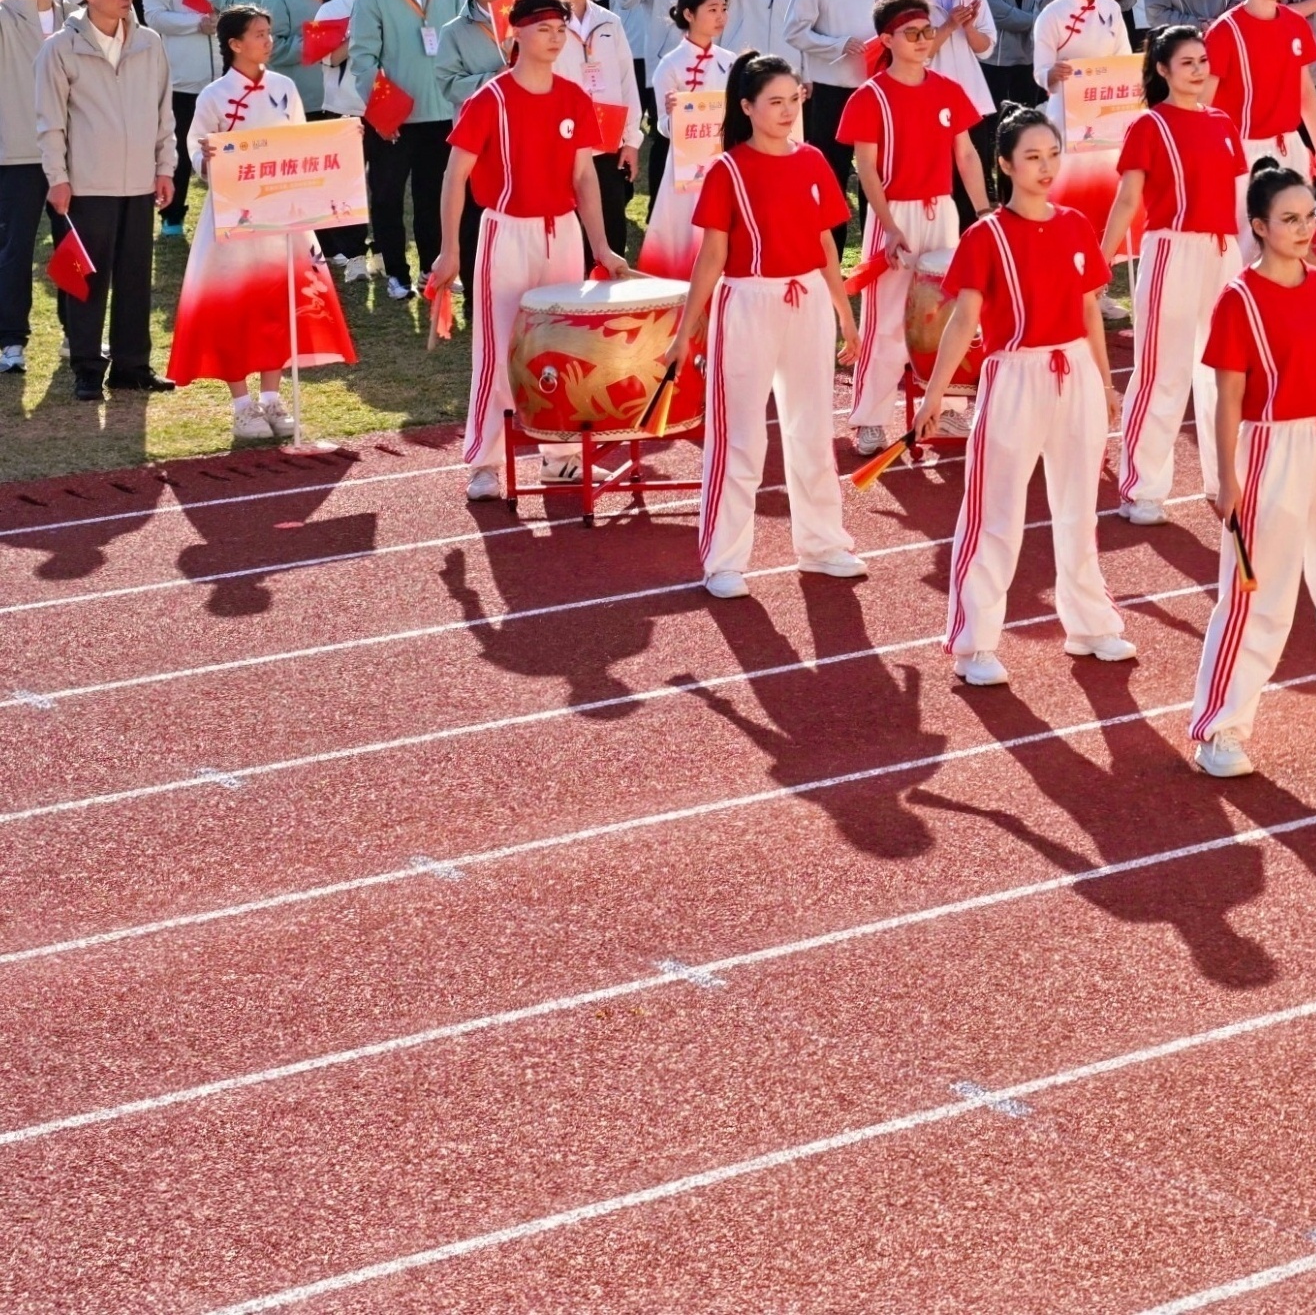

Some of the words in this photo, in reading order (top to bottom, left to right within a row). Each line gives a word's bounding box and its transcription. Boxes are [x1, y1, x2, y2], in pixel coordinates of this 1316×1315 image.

[1083, 83, 1145, 101] 组动出击
[237, 153, 341, 182] 法网恢恢队
